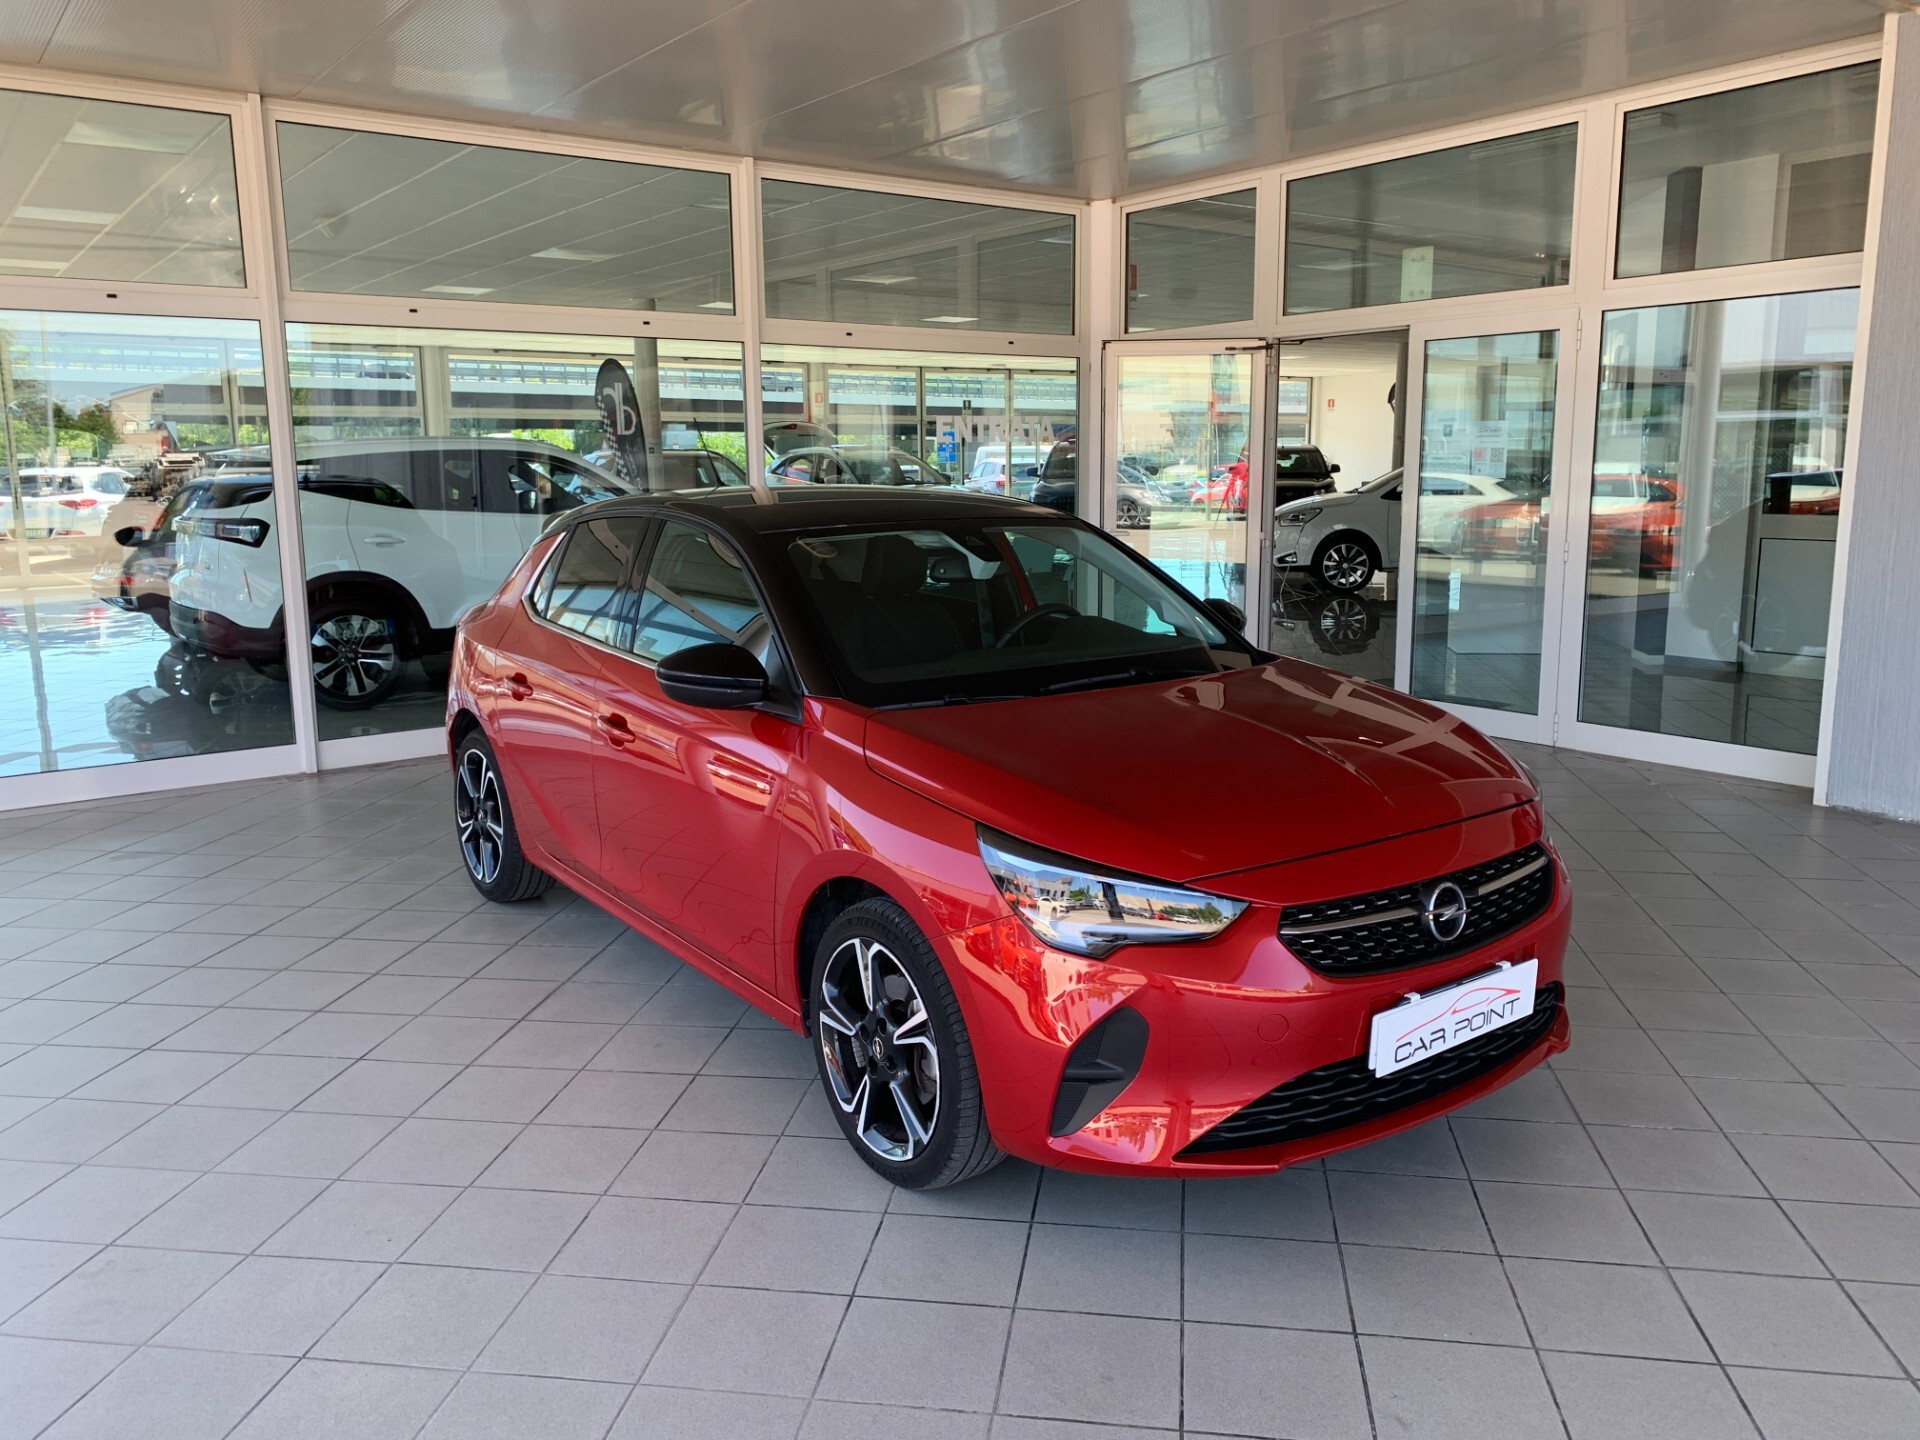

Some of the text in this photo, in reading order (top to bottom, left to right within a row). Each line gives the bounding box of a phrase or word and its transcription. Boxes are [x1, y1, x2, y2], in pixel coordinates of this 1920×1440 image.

[936, 415, 1056, 444] ENTRATA
[1394, 997, 1520, 1064] CAR POINT
